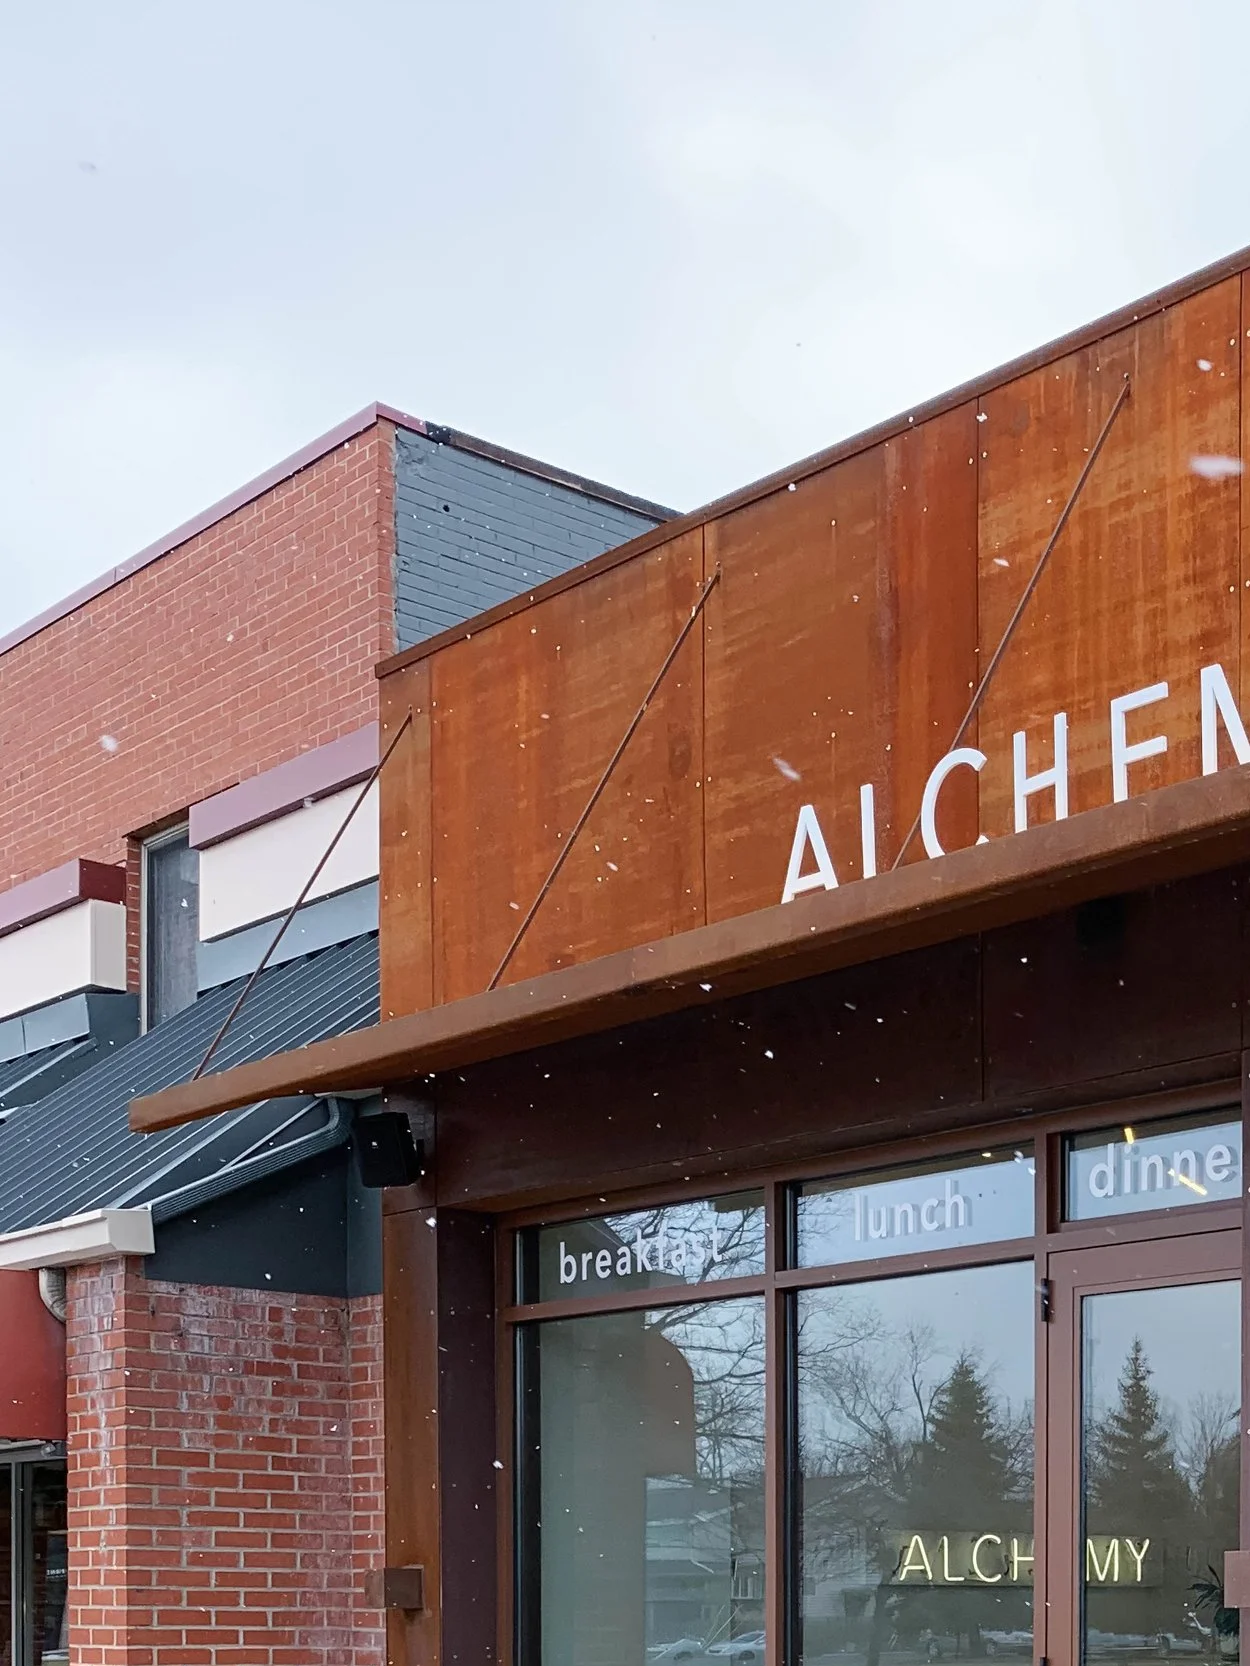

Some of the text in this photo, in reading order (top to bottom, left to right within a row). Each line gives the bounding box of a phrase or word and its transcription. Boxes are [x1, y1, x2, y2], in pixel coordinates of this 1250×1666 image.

[1088, 1142, 1232, 1198] dinne
[855, 1178, 965, 1241] lunch
[559, 1218, 723, 1284] breakfast
[899, 1534, 1150, 1583] ALCHMY
